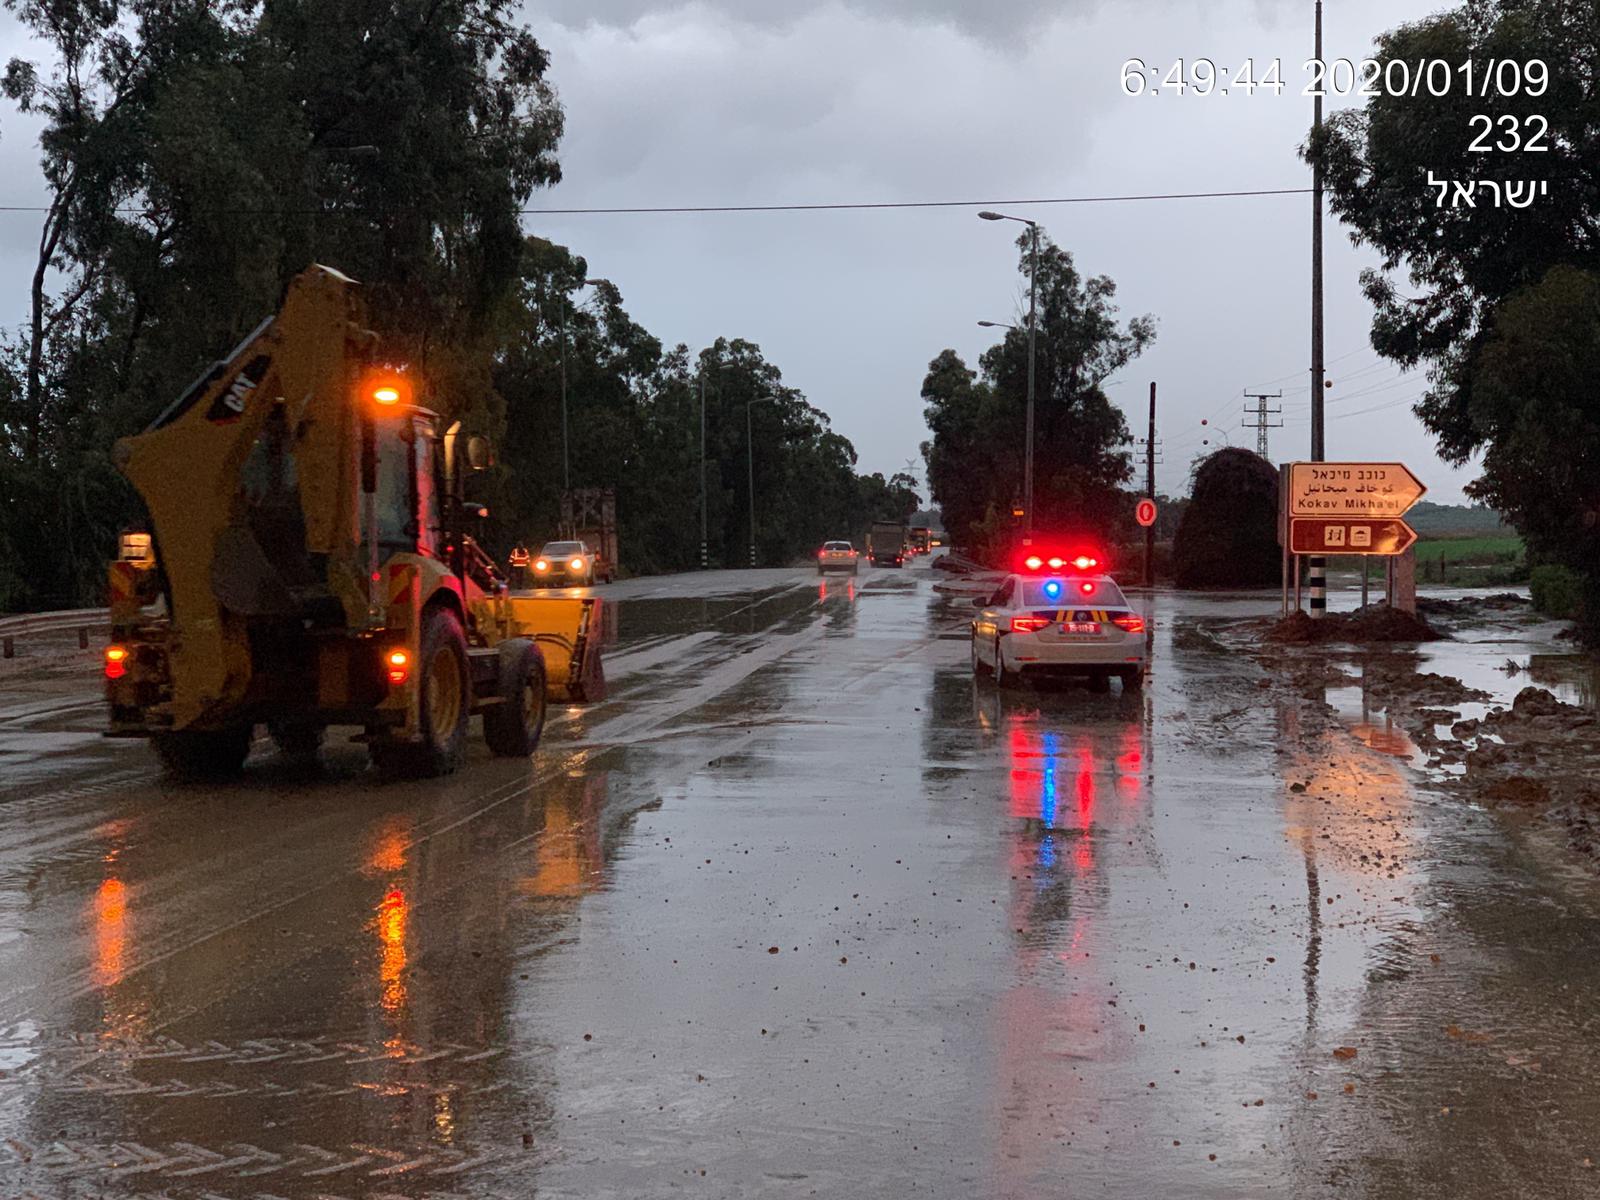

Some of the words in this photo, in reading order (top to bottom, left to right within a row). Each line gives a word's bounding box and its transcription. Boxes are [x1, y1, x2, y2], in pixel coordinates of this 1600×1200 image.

[224, 372, 257, 412] CAT
[1312, 469, 1351, 480] מיכאל
[1358, 469, 1386, 480] כוכב
[1298, 499, 1337, 509] Kokav
[1345, 499, 1399, 509] Mikha'el
